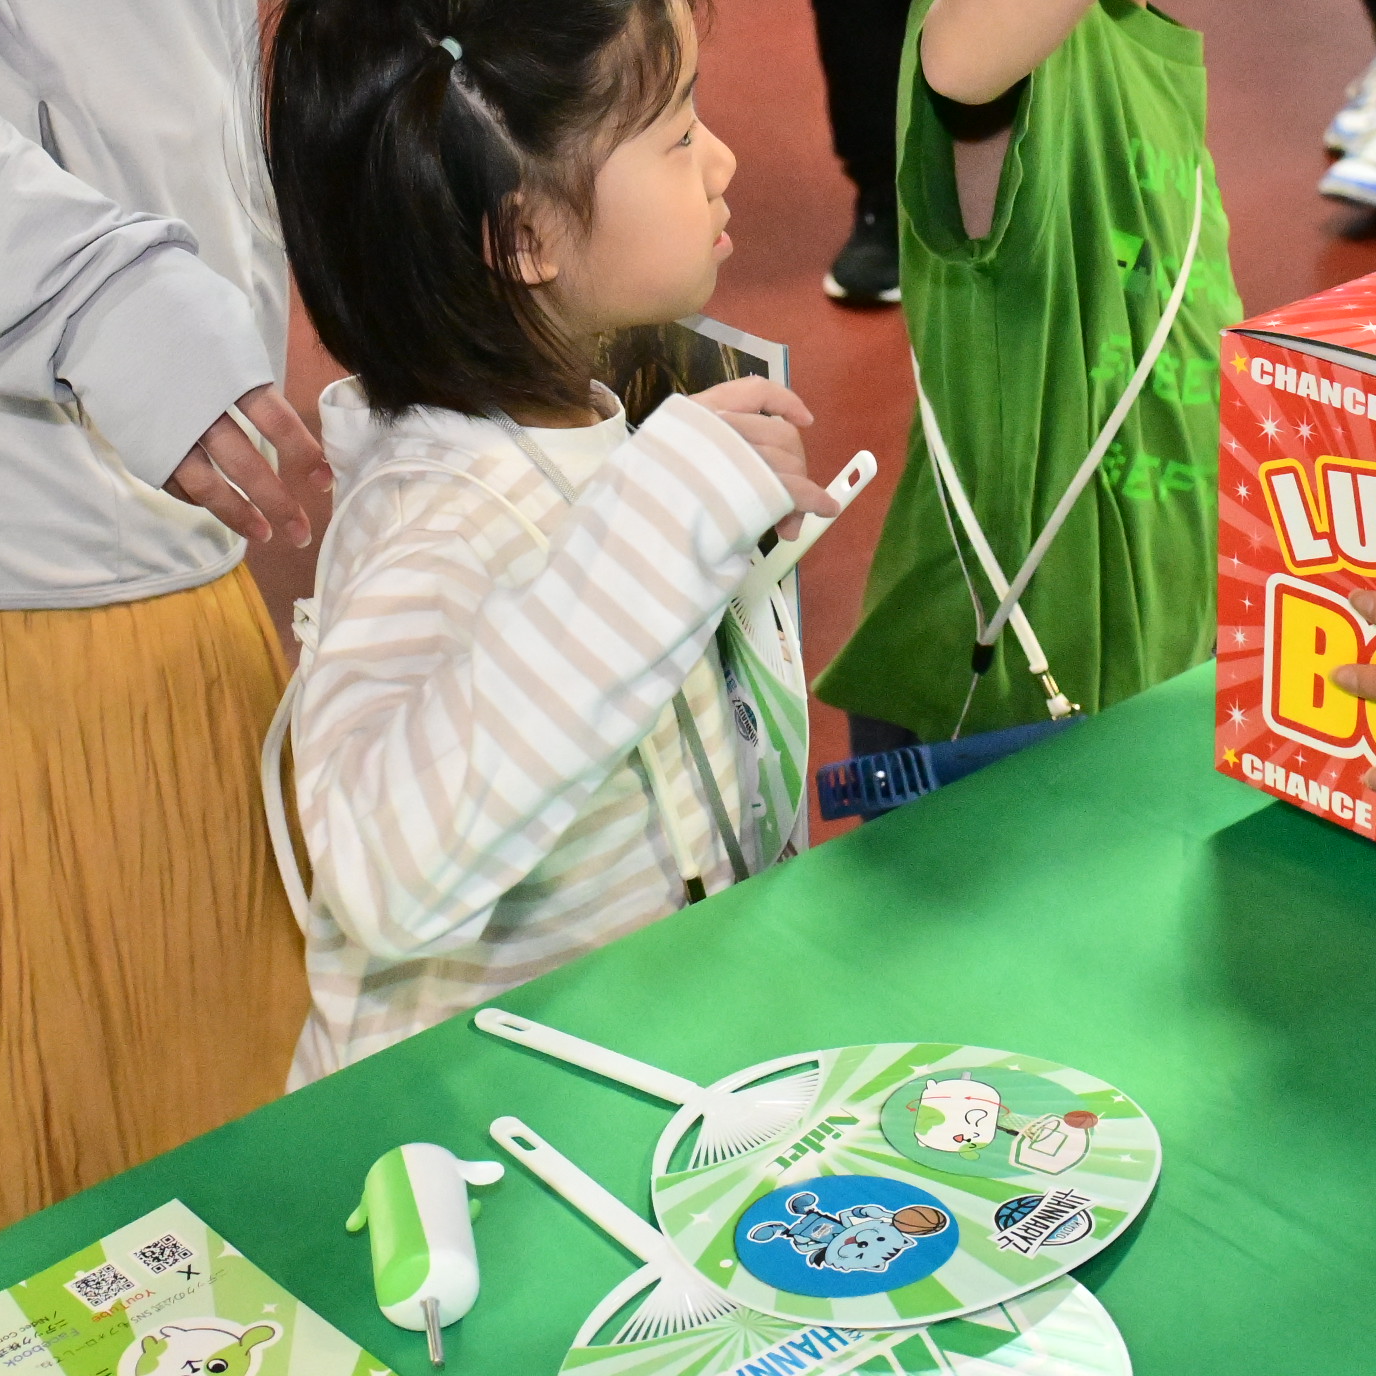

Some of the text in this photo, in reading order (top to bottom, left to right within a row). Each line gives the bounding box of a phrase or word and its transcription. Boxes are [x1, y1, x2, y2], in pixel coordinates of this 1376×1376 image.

[1241, 753, 1373, 830] CHANCE
[765, 1107, 860, 1176] Nidec
[997, 1189, 1091, 1253] HANNARYZ
[176, 1264, 201, 1280] X
[91, 1288, 156, 1323] YouTube
[3, 1327, 80, 1367] Facebook
